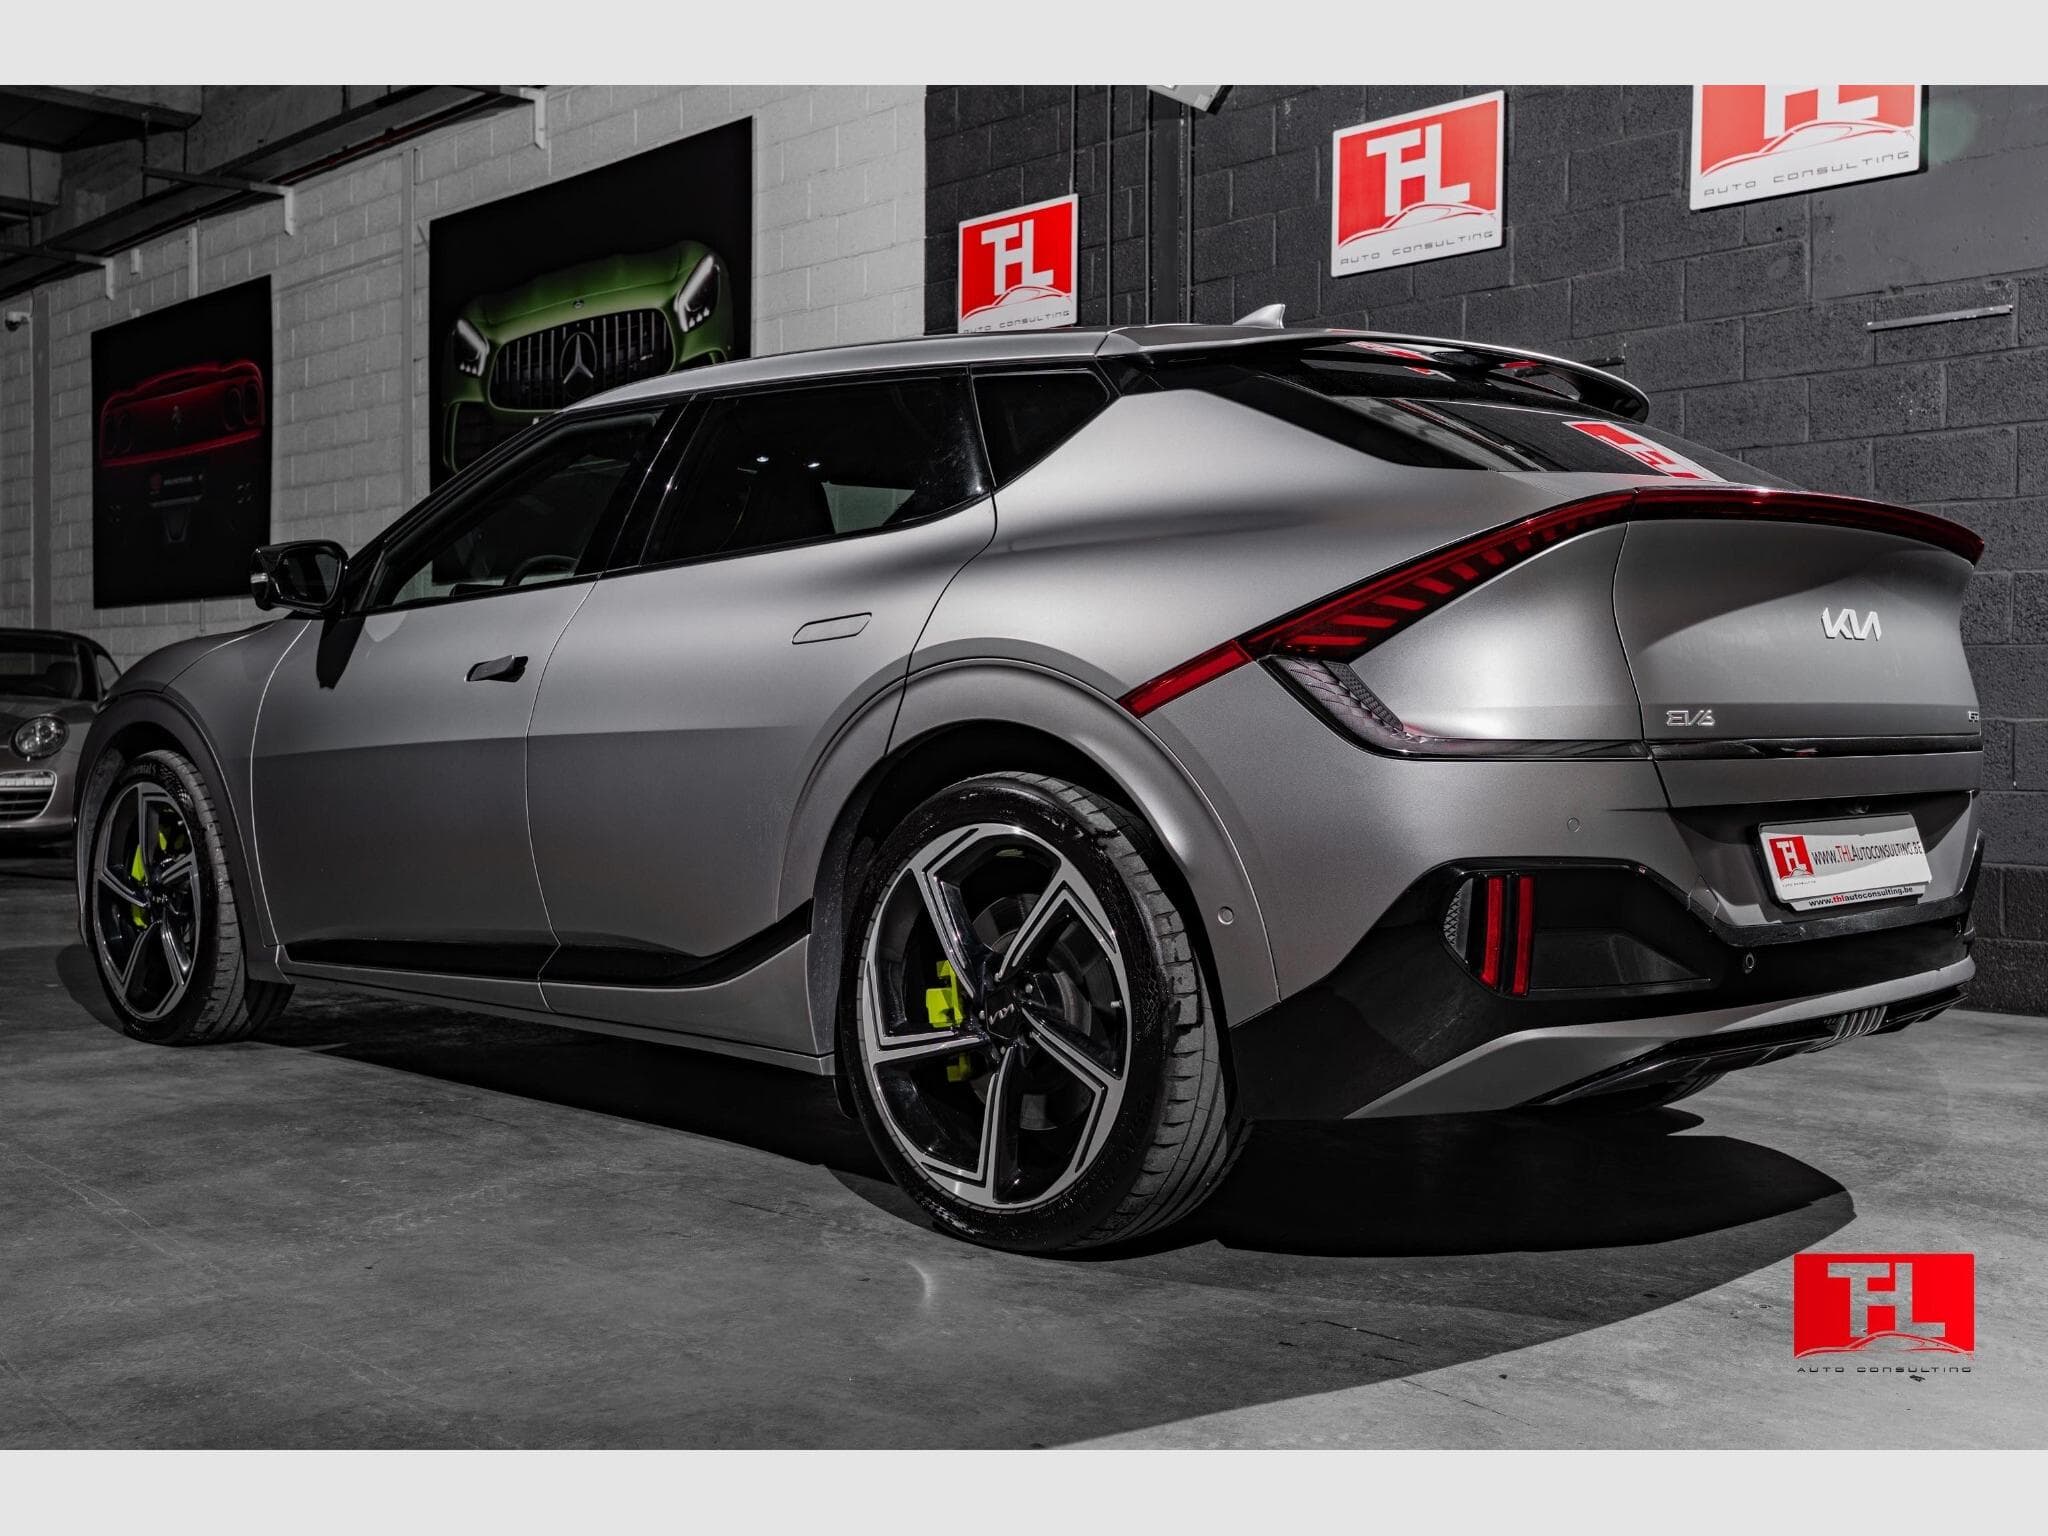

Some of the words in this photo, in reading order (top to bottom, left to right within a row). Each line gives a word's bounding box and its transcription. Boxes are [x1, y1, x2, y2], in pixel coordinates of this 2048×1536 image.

[1366, 122, 1471, 217] THL
[1703, 180, 1756, 196] AUTO
[1773, 150, 1910, 184] CONSULTING
[981, 218, 1054, 297] THL
[1340, 251, 1380, 265] AUTO
[1392, 230, 1494, 256] CONSULTING
[999, 309, 1070, 329] CONSULTING
[1666, 709, 1716, 727] EV6
[1776, 840, 1808, 872] THL
[1808, 886, 1913, 907] www.thlautoconsulting.be
